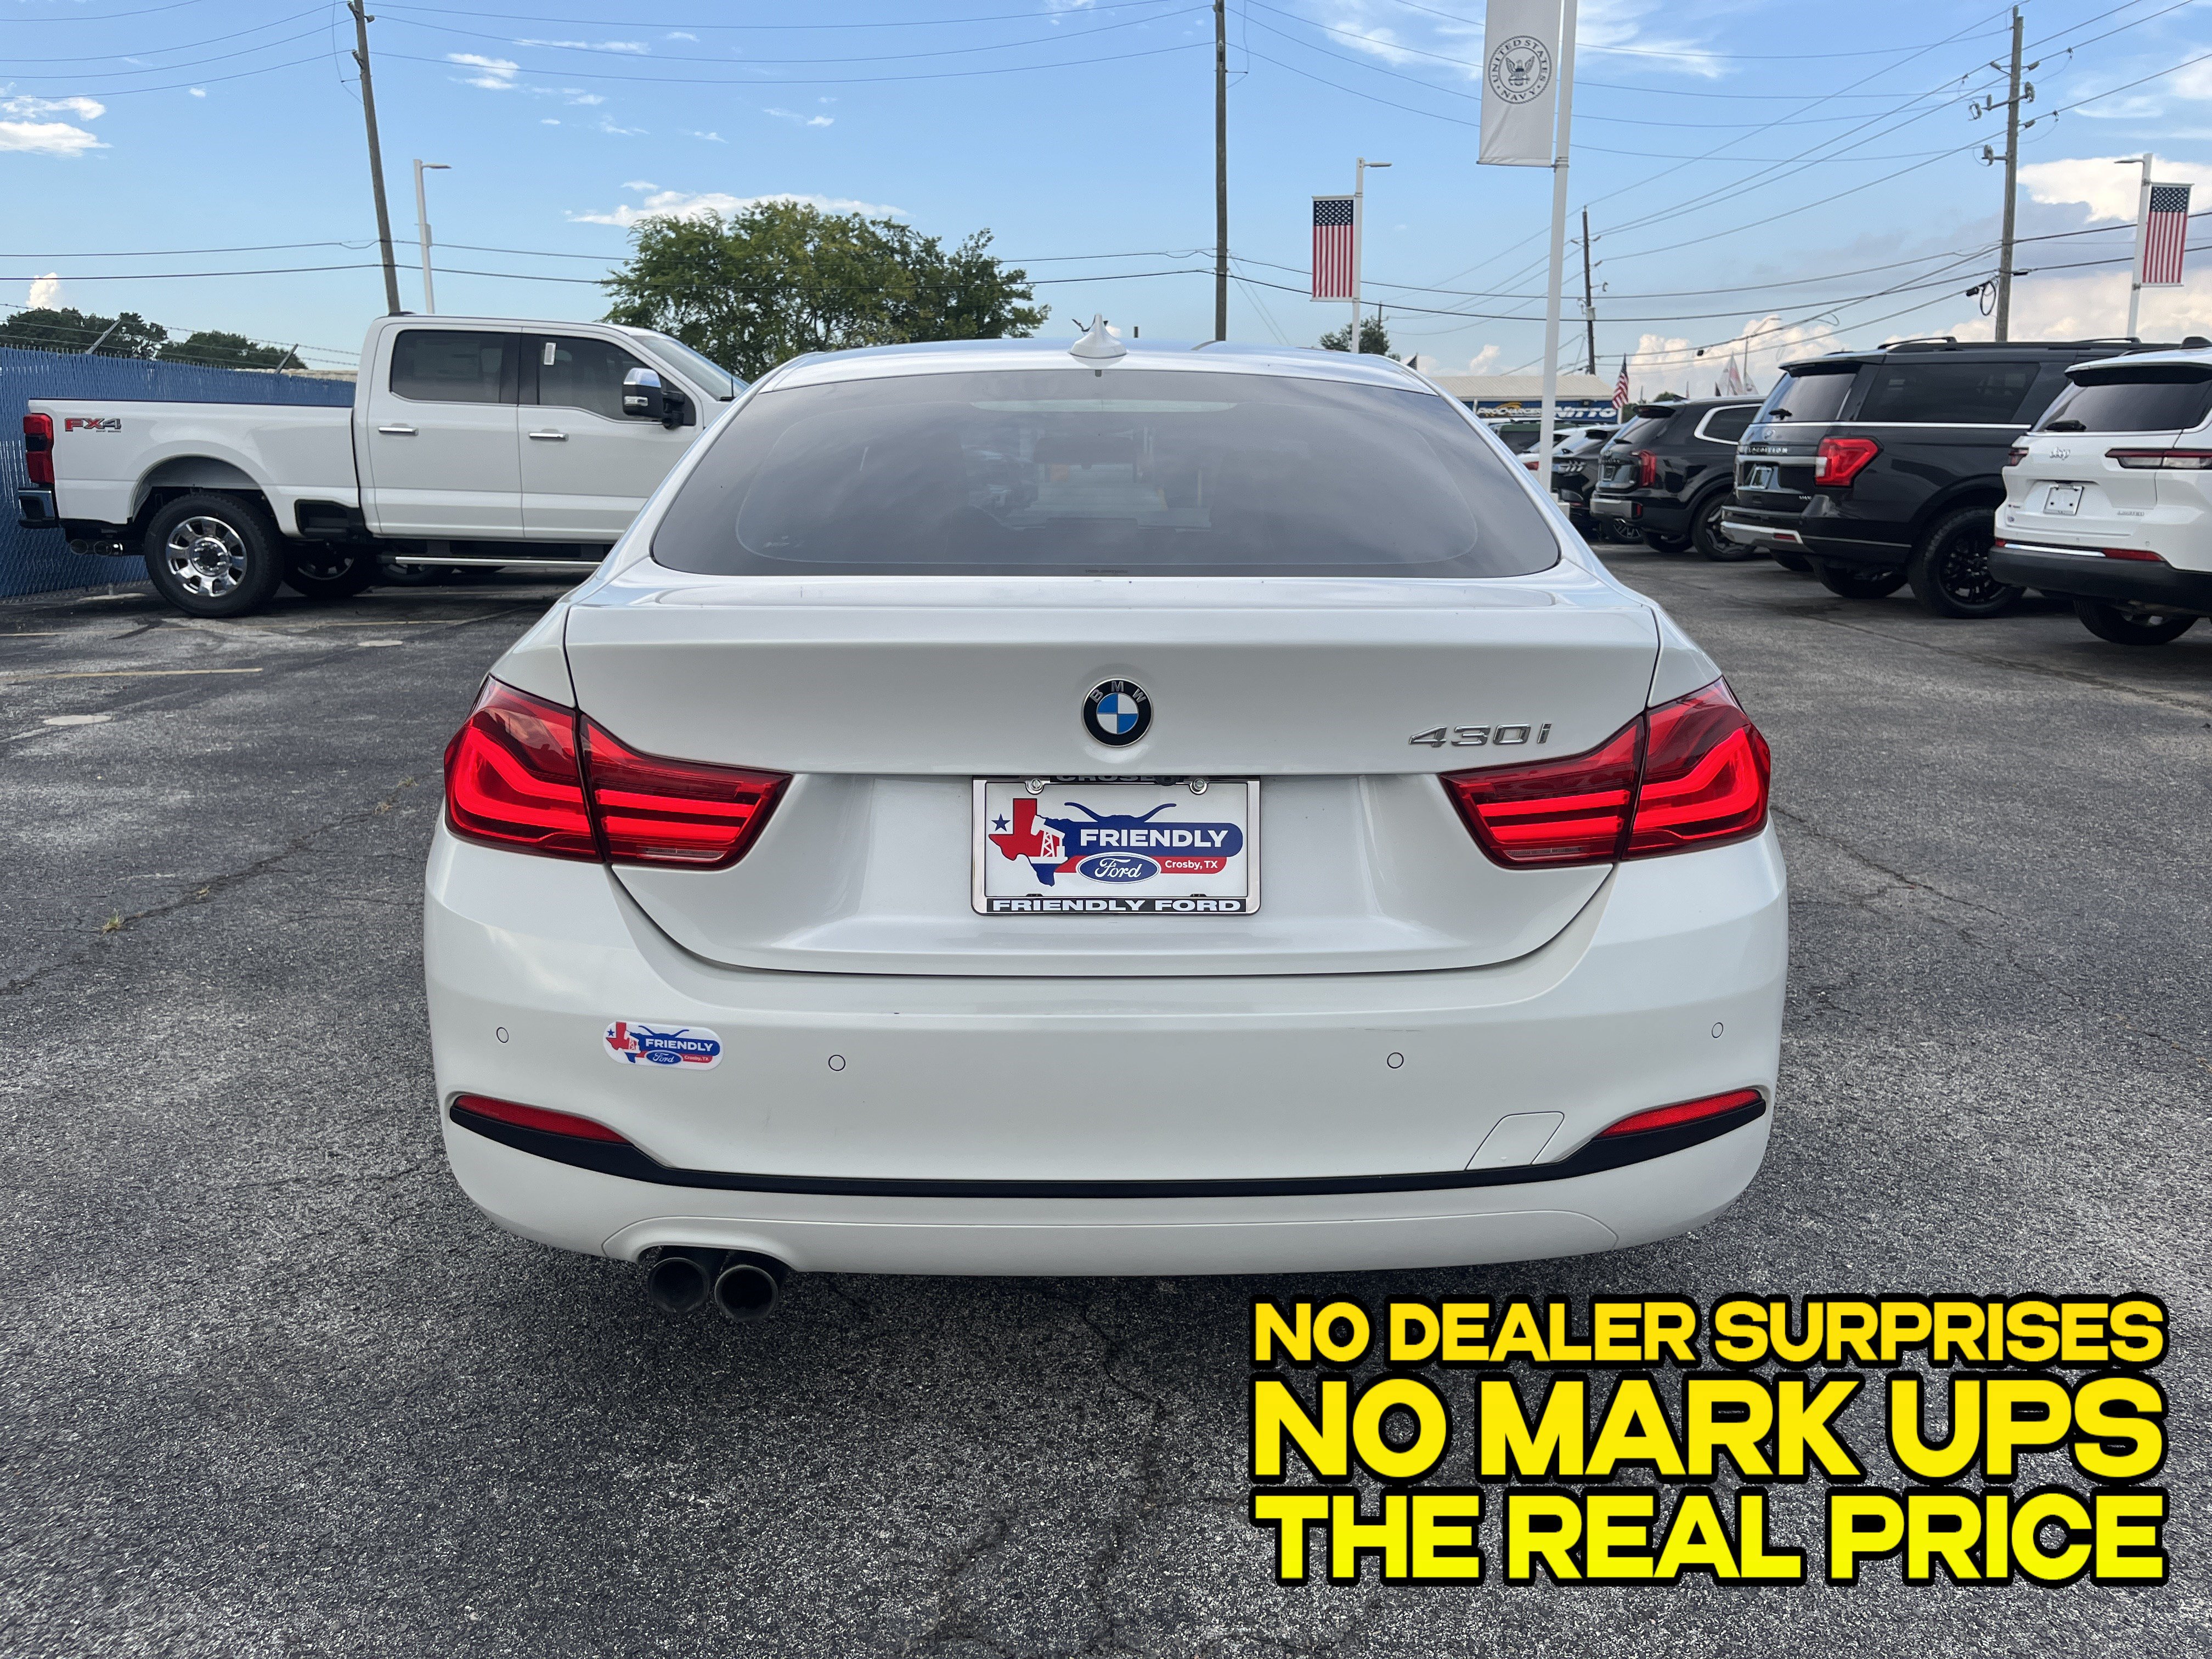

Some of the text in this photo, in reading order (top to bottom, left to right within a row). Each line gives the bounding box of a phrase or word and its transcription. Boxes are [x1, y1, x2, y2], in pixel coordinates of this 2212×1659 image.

[1491, 40, 1548, 82] UNITED STATES
[1500, 88, 1536, 101] NAVY
[1554, 407, 1617, 418] NITTO
[65, 418, 121, 432] FX4
[1089, 681, 1147, 703] BMW
[1408, 723, 1552, 747] 430i
[1080, 829, 1229, 848] FRIENDLY
[1094, 857, 1142, 878] Ford
[1165, 860, 1218, 870] Crosby, TX
[992, 900, 1241, 912] FRIENDLY FORD
[645, 1038, 714, 1052] FRIENDLY
[652, 1052, 675, 1063] Ford
